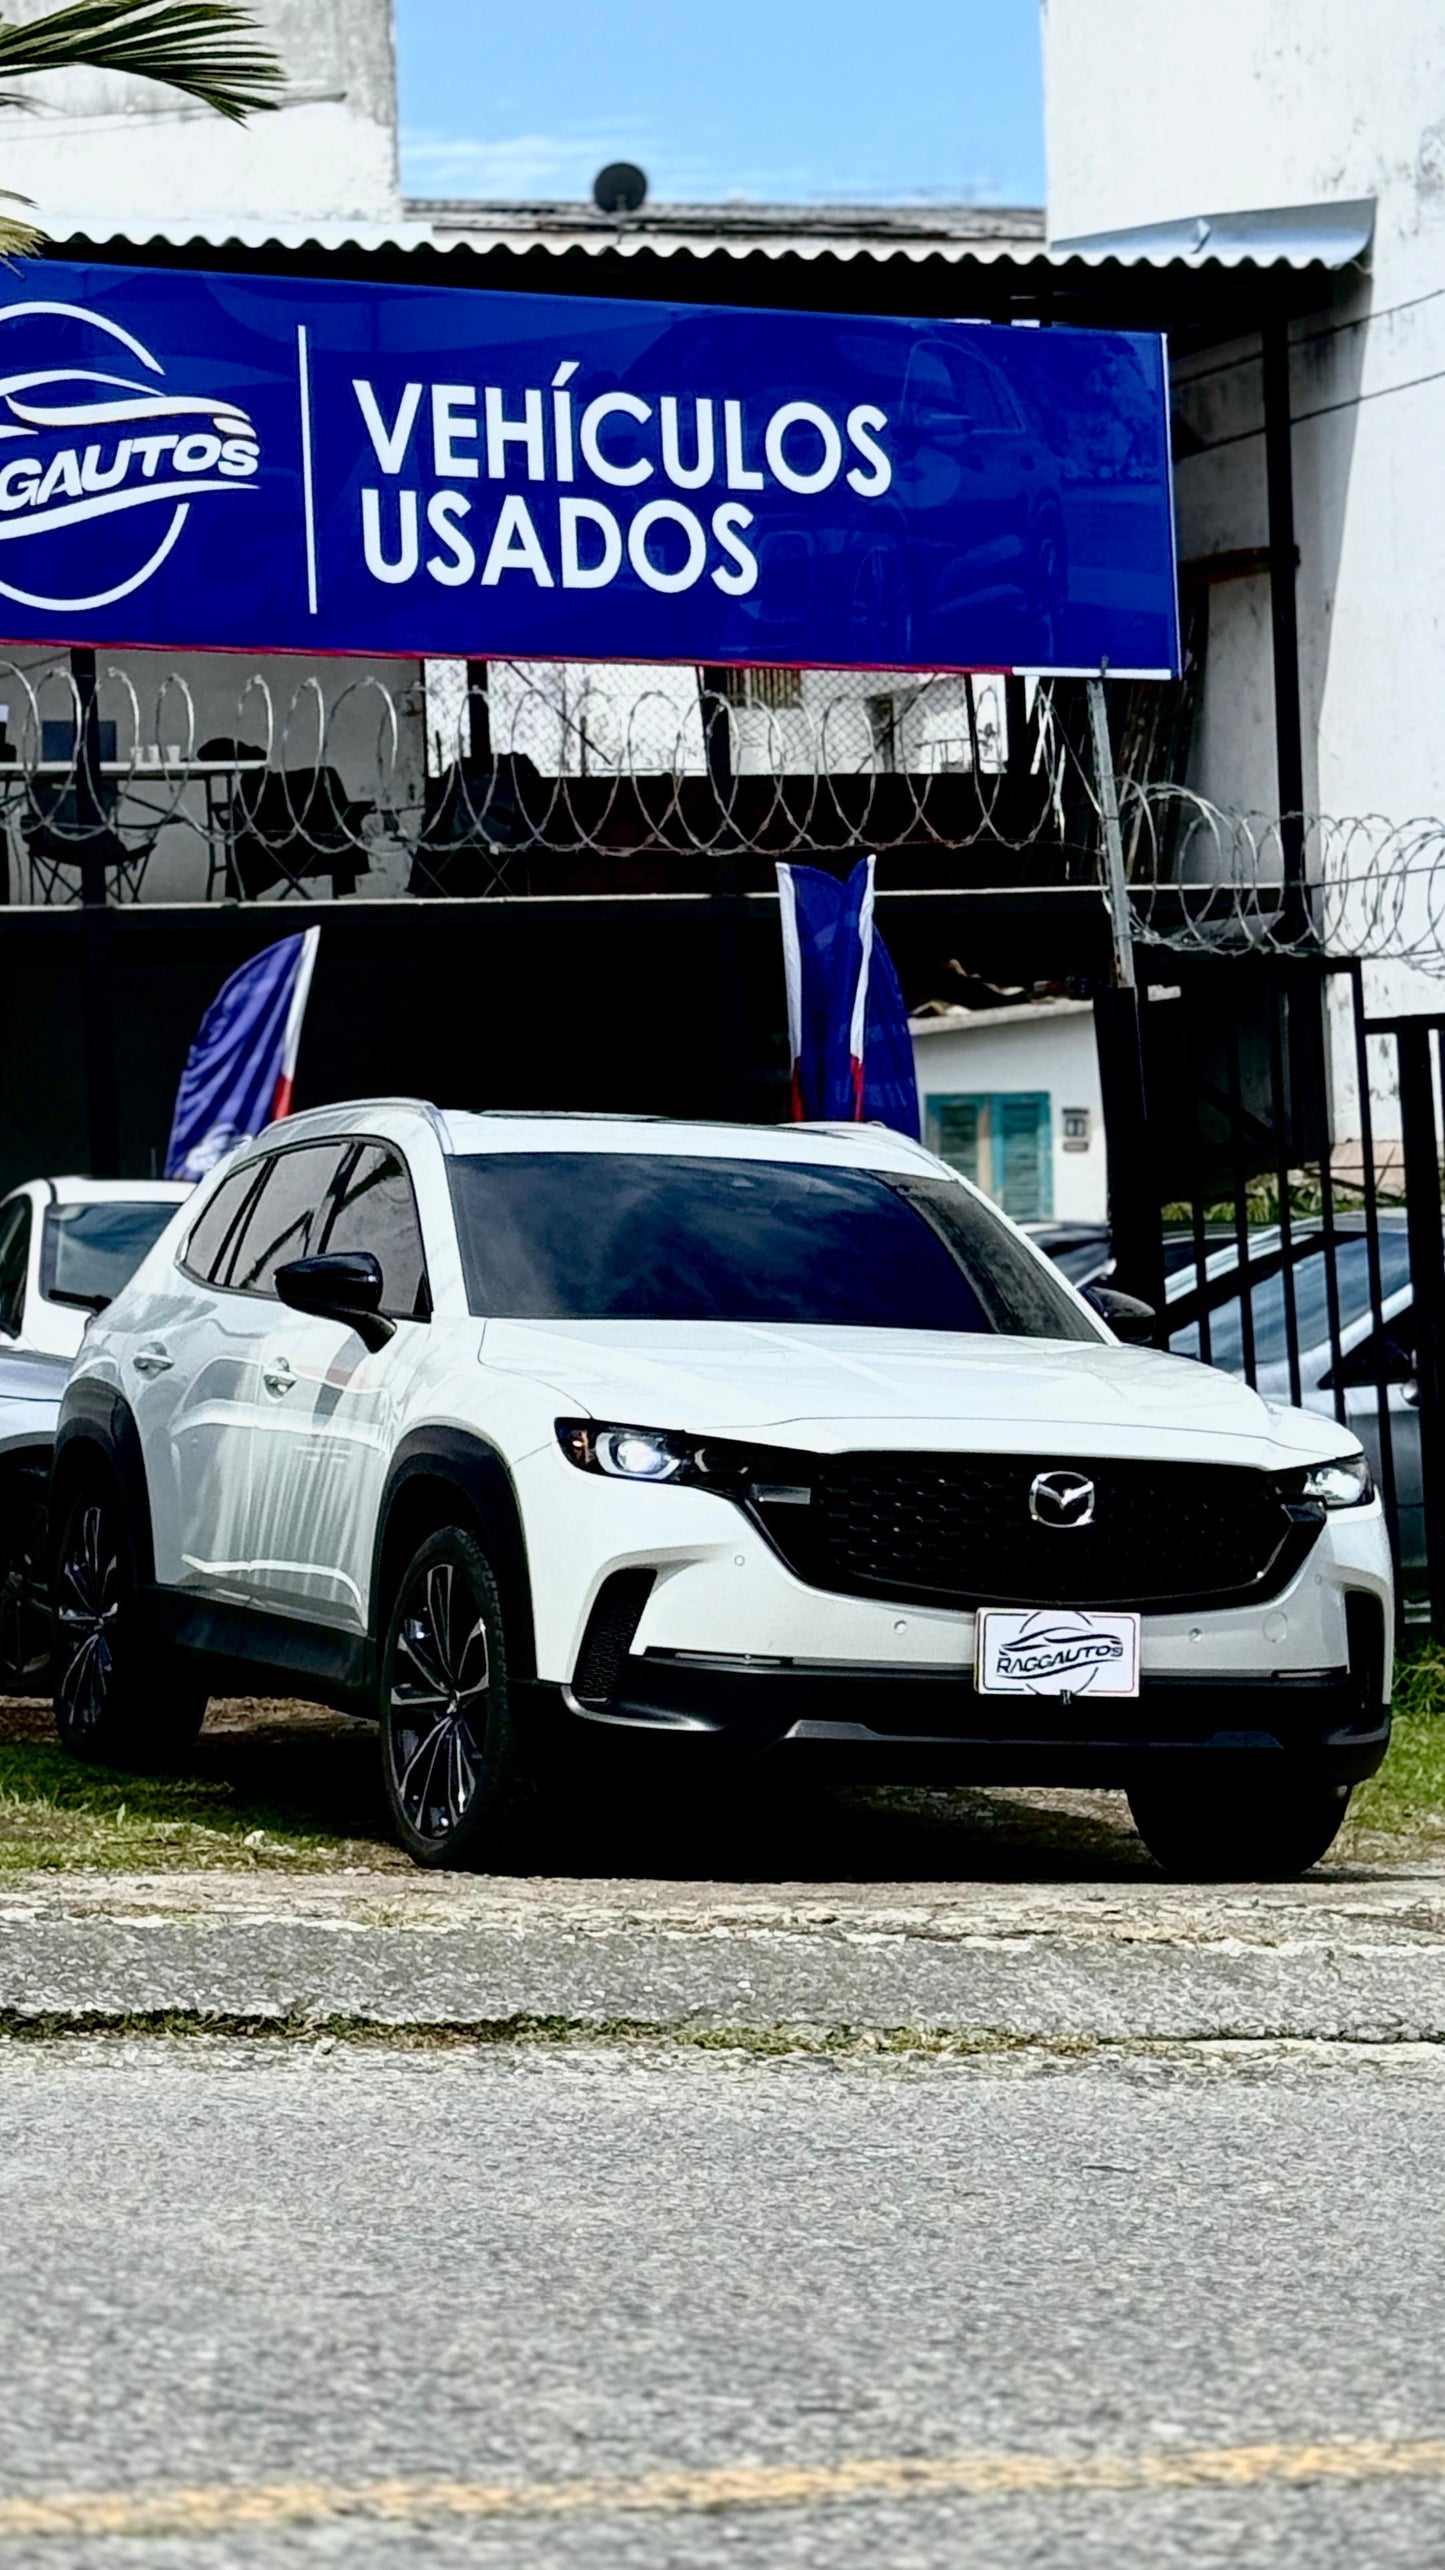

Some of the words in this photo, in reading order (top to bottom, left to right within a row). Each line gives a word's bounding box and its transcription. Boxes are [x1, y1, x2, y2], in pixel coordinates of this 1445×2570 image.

[351, 361, 893, 498] VEHÍCULOS
[361, 487, 759, 596] USADOS
[996, 1645, 1124, 1674] RAGGAUTOS
